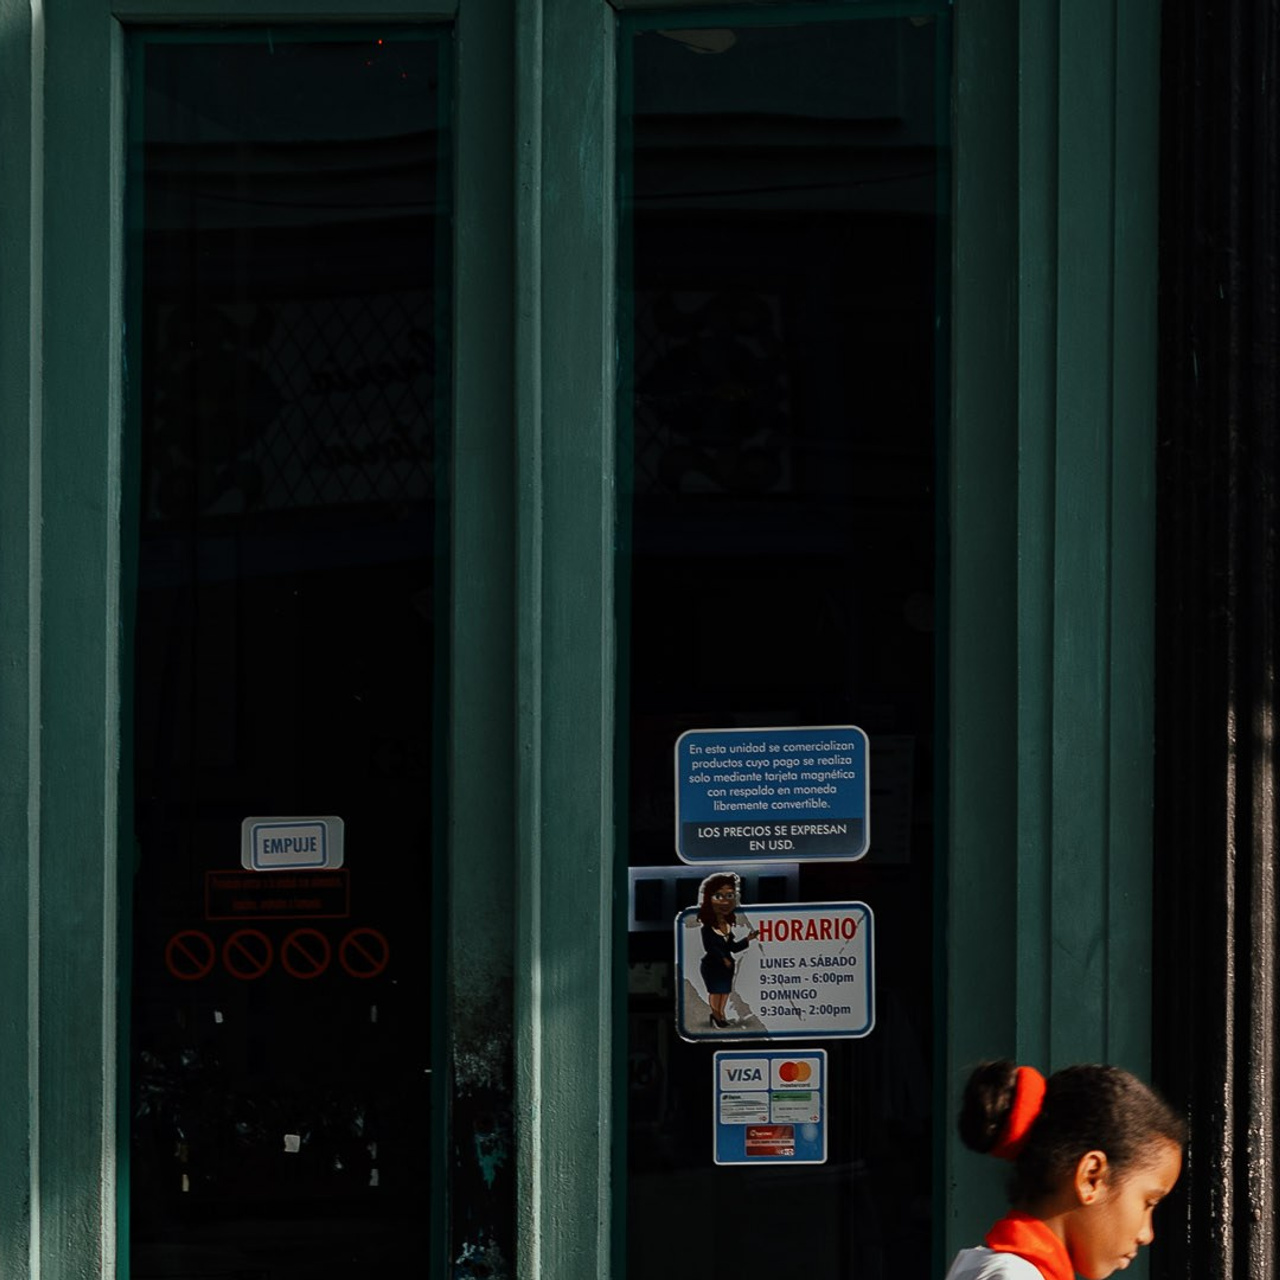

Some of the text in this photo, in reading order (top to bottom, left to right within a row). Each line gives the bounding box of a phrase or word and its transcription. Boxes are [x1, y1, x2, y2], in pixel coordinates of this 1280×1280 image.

[689, 740, 855, 754] En esta unidad se comercializan
[691, 755, 852, 770] productos cuyo pago se realiza
[689, 769, 855, 783] solo mediante tarjeta magnética
[707, 784, 837, 798] con respaldo en moneda
[713, 798, 831, 811] libremente convertible.
[698, 824, 847, 838] LOS PRECIOS SE EXPRESAN
[263, 837, 317, 854] EMPUJE
[749, 839, 795, 851] EN USD.
[759, 917, 856, 942] HORARIO
[760, 954, 857, 969] LUNES A SÁBADO
[759, 974, 801, 985] 9:30am
[812, 973, 854, 986] 6:00pm
[760, 989, 817, 1001] DOMINGO
[760, 1005, 800, 1017] 9:30am
[809, 1004, 851, 1017] 2:00pm
[726, 1068, 762, 1081] VISA
